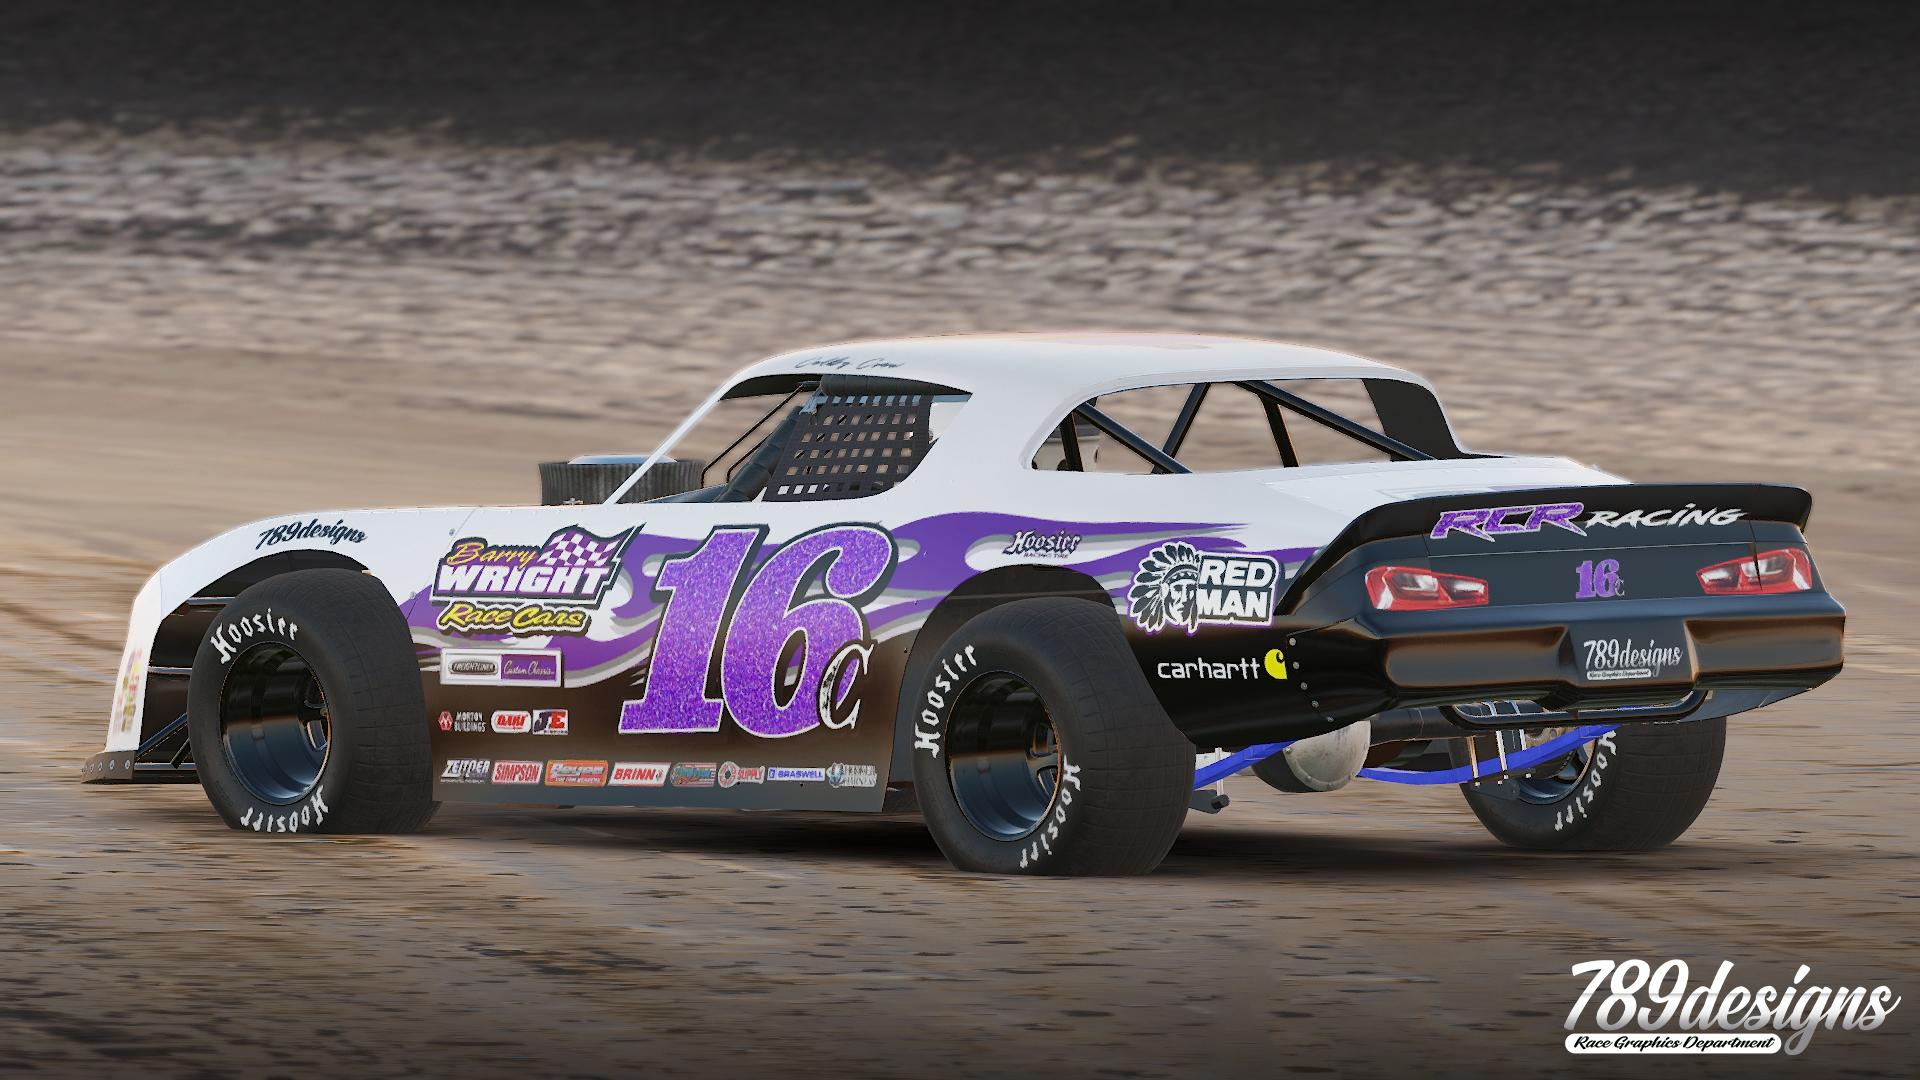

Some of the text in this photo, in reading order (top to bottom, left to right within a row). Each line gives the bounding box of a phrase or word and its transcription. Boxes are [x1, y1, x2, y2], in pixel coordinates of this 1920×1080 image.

[255, 518, 368, 550] 789designs
[1430, 502, 1587, 542] RCR
[447, 542, 536, 570] Barry
[1002, 529, 1082, 555] Hoosier
[437, 564, 609, 594] WRIGHT
[1199, 558, 1273, 587] RED
[440, 603, 583, 629] Race Cars
[1196, 589, 1268, 617] MAN
[210, 608, 298, 664] Hoosier
[1157, 657, 1260, 679] carhartt
[1583, 639, 1683, 678] 789designs
[914, 644, 977, 758] Hoosier
[453, 721, 486, 733] BUILDINGS
[455, 711, 483, 722] MORTON
[495, 764, 539, 781] SIMPSON
[614, 768, 656, 780] BRINN
[777, 769, 823, 778] BRASWELL
[240, 785, 329, 832] Hoosier
[1020, 752, 1081, 868] Hoosier
